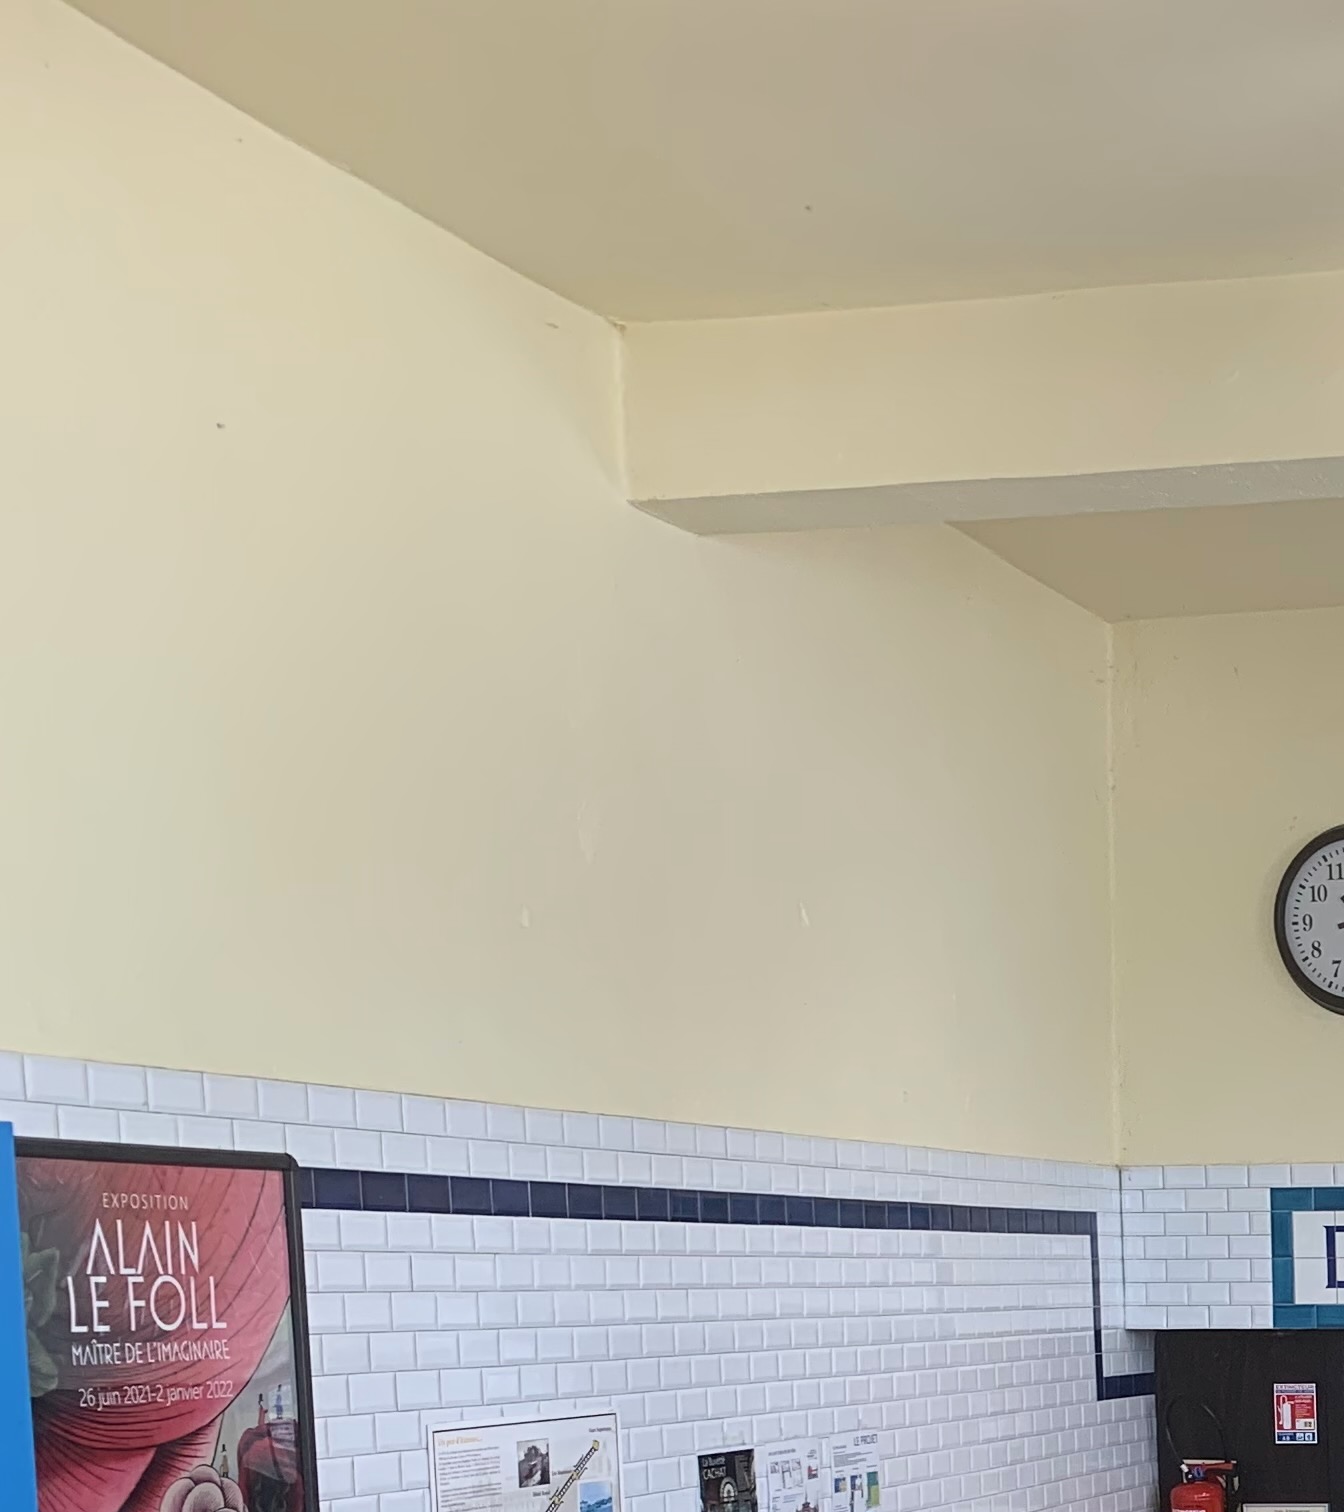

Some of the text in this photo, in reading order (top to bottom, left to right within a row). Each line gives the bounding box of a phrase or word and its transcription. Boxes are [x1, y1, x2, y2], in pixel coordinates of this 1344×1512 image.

[1327, 863, 1344, 881] 11
[1309, 884, 1328, 903] 10
[1302, 914, 1313, 932] 9
[1311, 940, 1322, 958] 8
[1332, 960, 1342, 978] 7
[102, 1192, 189, 1210] EXPOSITION
[86, 1218, 200, 1275] ALAIN
[67, 1275, 227, 1333] LE FOLL
[72, 1339, 231, 1366] MAÎTRE DE L'IMAGINAIRE
[78, 1388, 96, 1407] 26
[97, 1388, 122, 1411] juin
[166, 1384, 204, 1406] janvier
[206, 1380, 234, 1399] 2022
